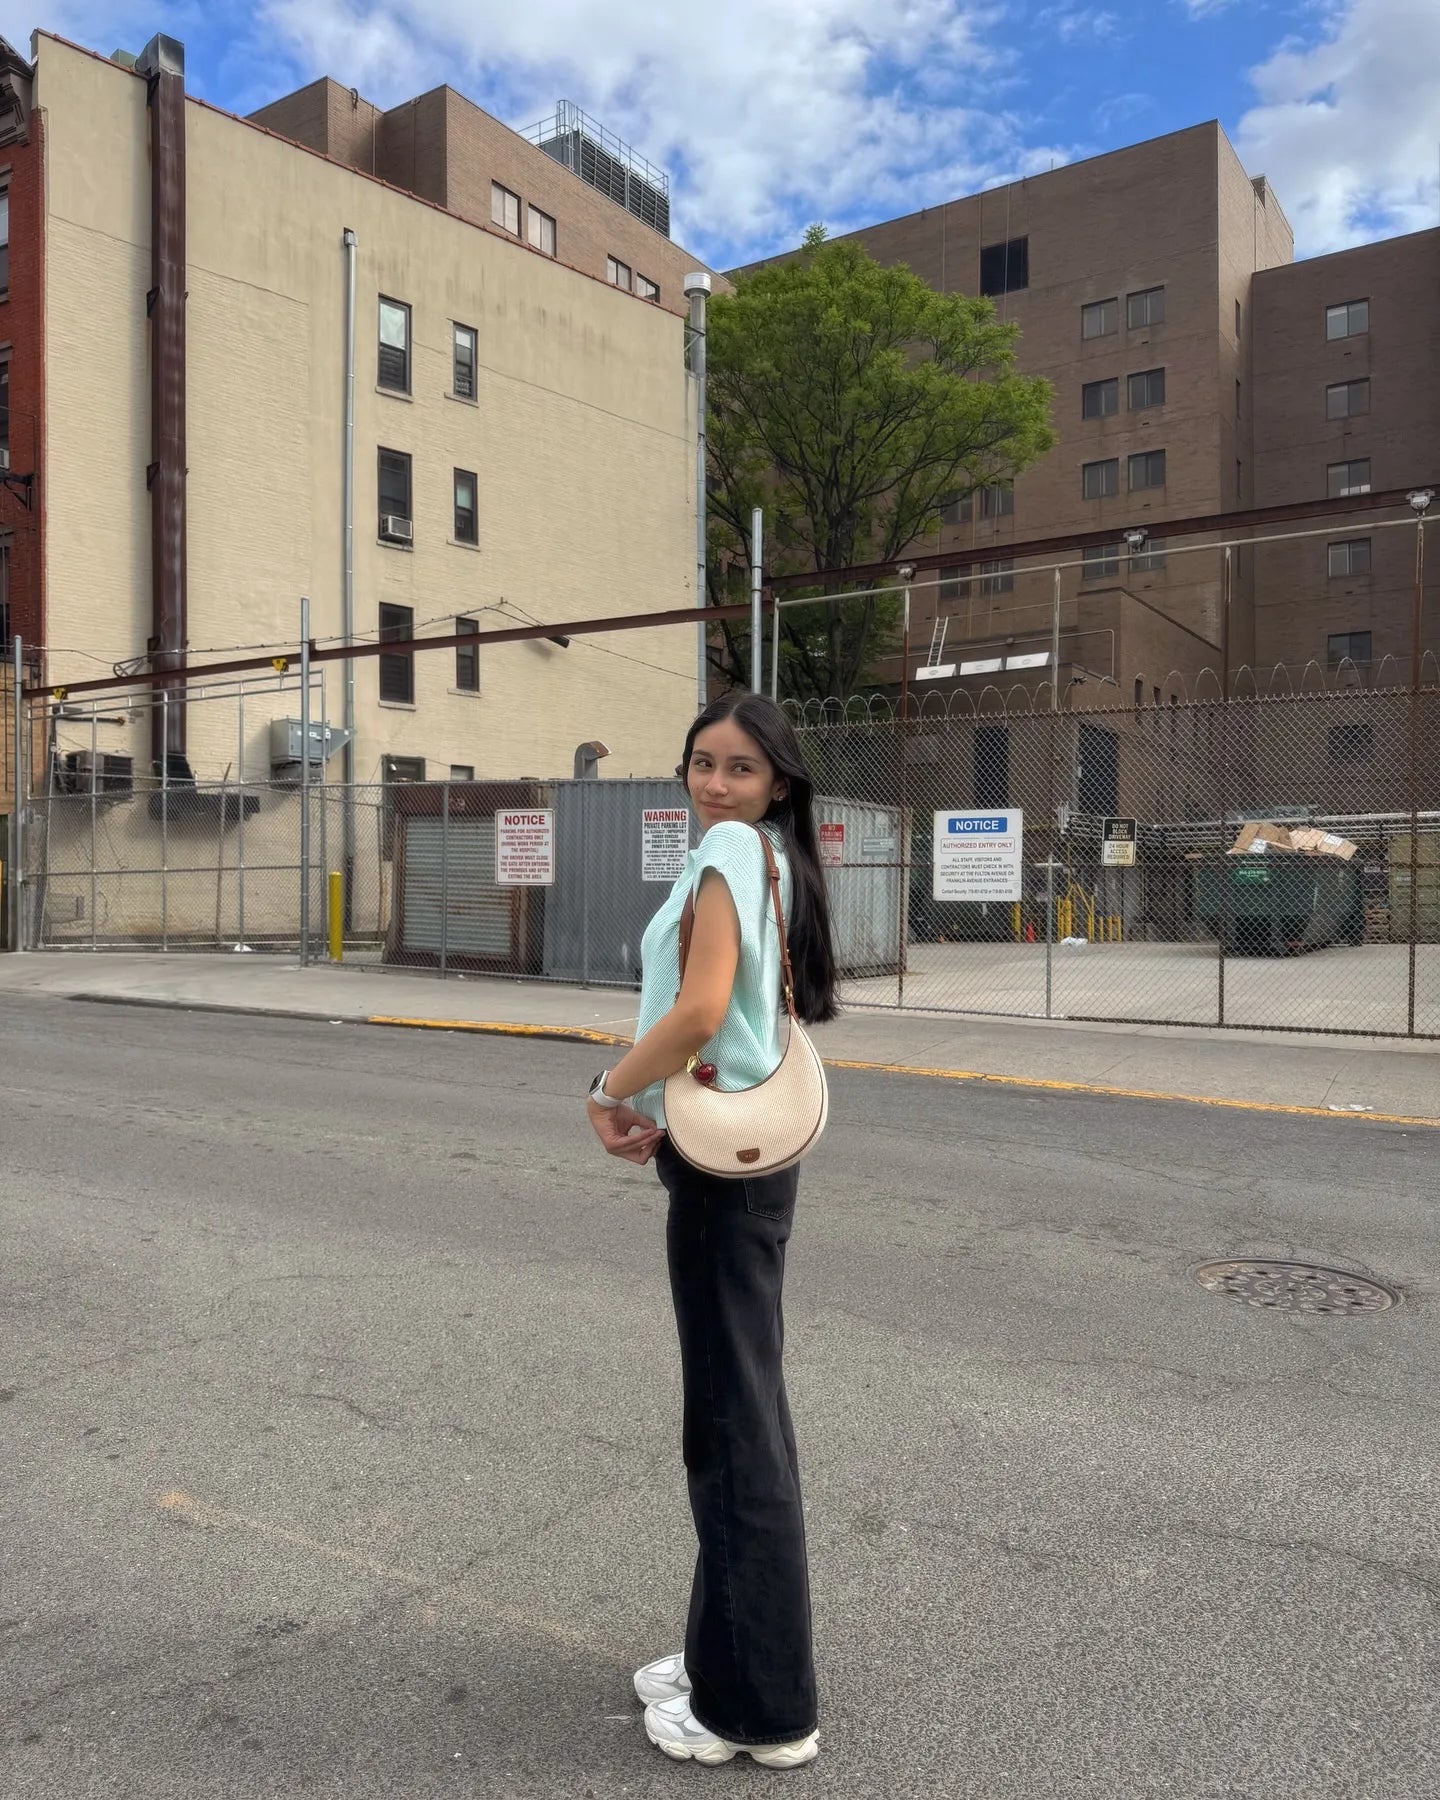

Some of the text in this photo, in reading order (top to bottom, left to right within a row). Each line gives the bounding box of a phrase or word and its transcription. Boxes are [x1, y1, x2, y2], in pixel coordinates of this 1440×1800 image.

[504, 815, 545, 825] NOTICE
[644, 811, 686, 821] WARNING
[956, 820, 999, 830] NOTICE
